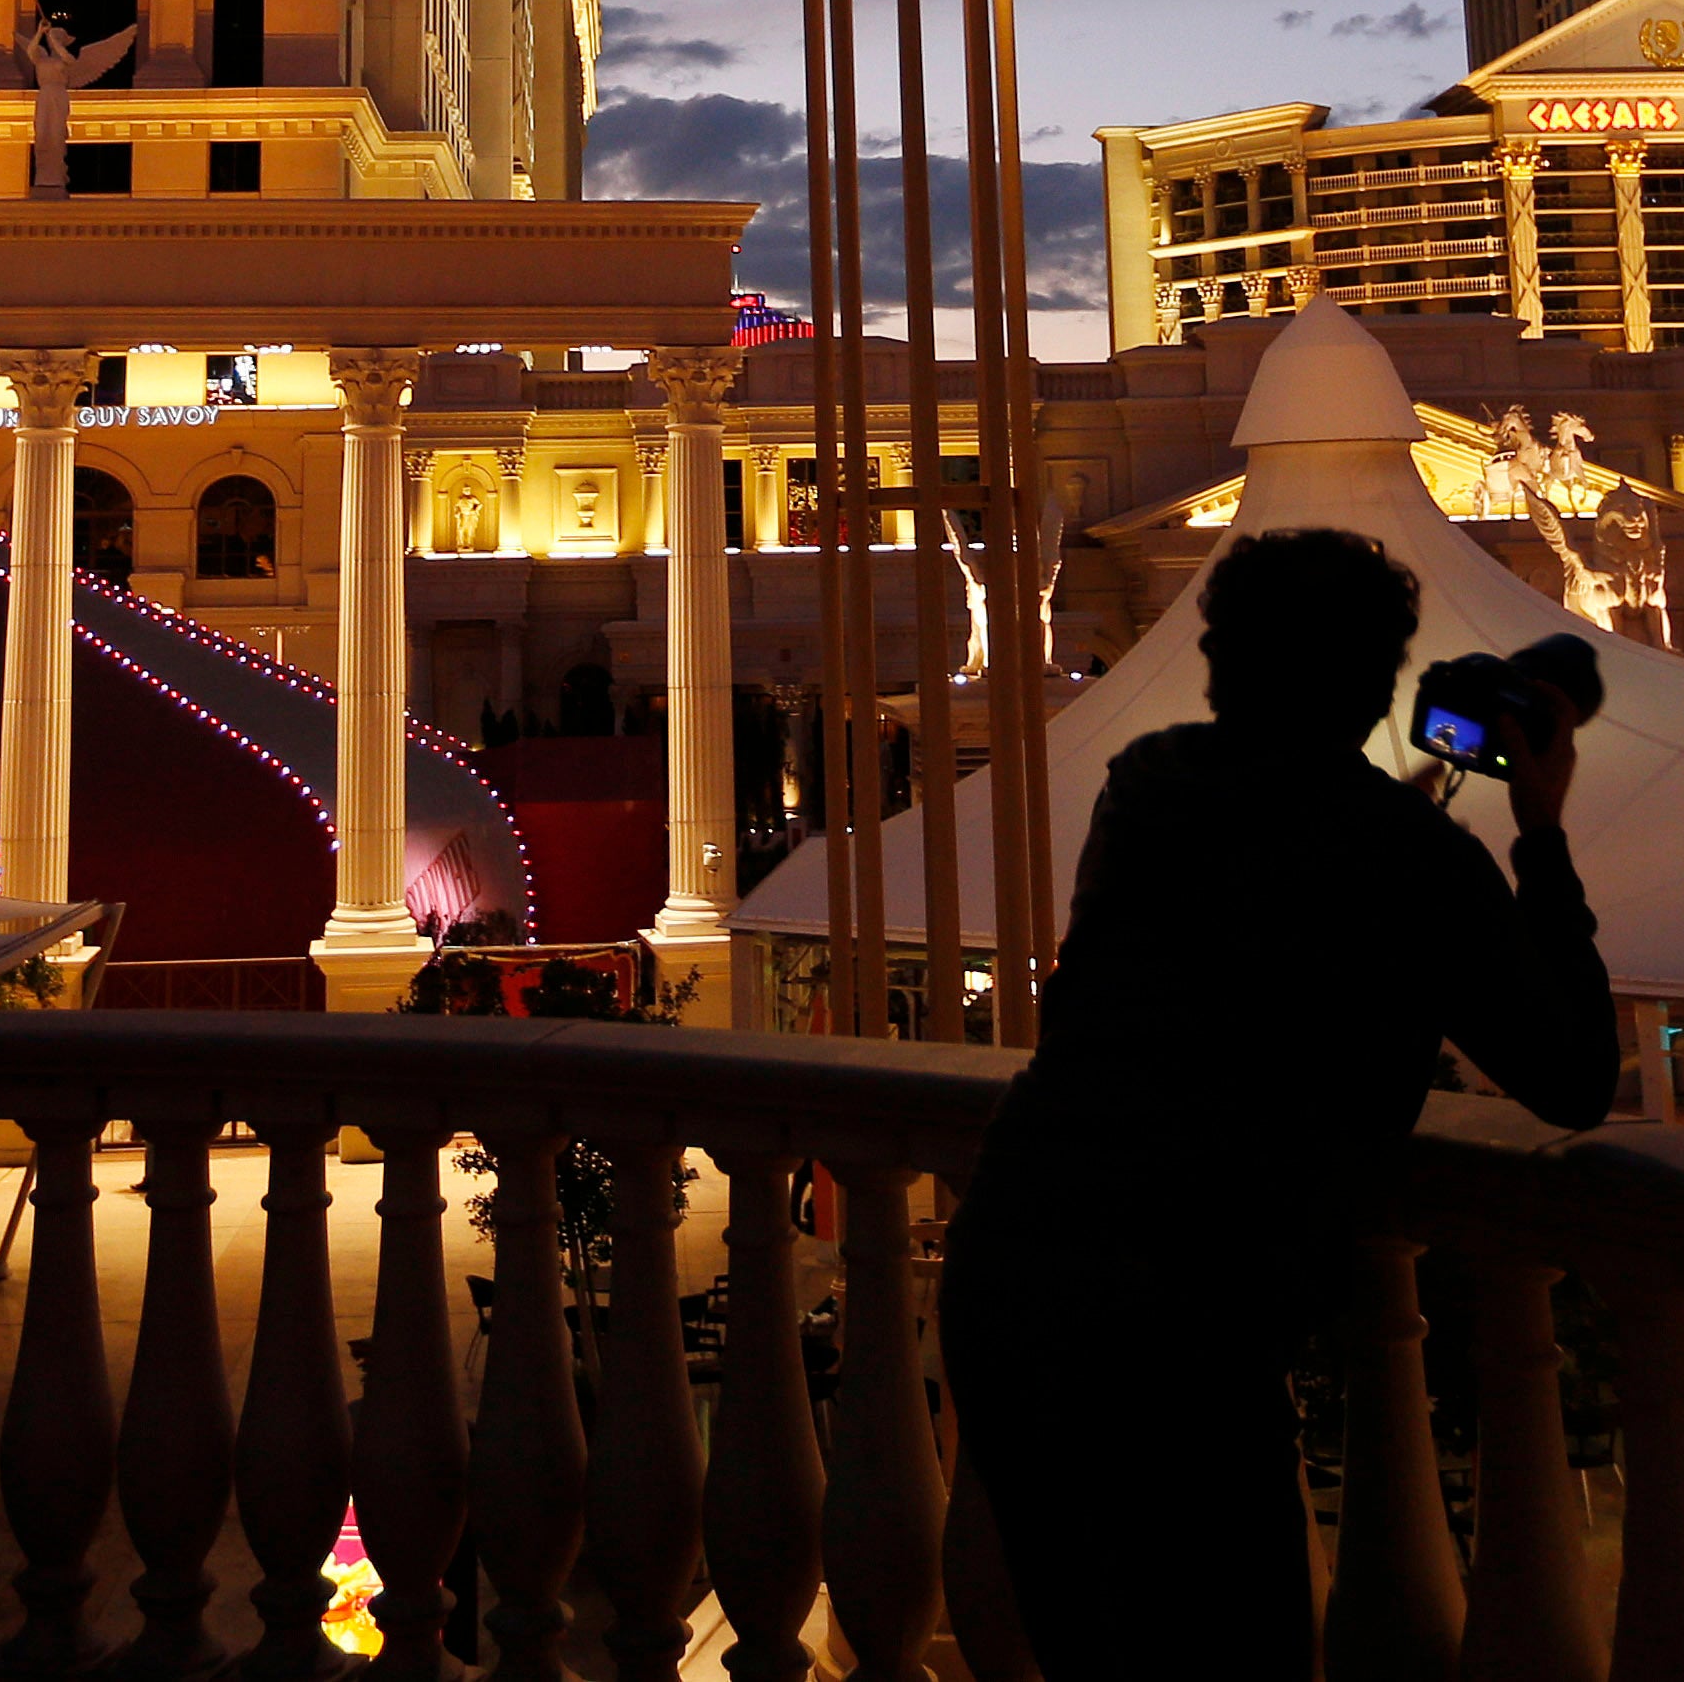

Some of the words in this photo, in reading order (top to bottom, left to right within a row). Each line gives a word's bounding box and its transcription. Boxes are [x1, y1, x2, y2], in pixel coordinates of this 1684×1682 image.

[1527, 99, 1680, 131] CAESARS
[78, 406, 130, 427] GUY
[136, 405, 220, 427] SAVOY
